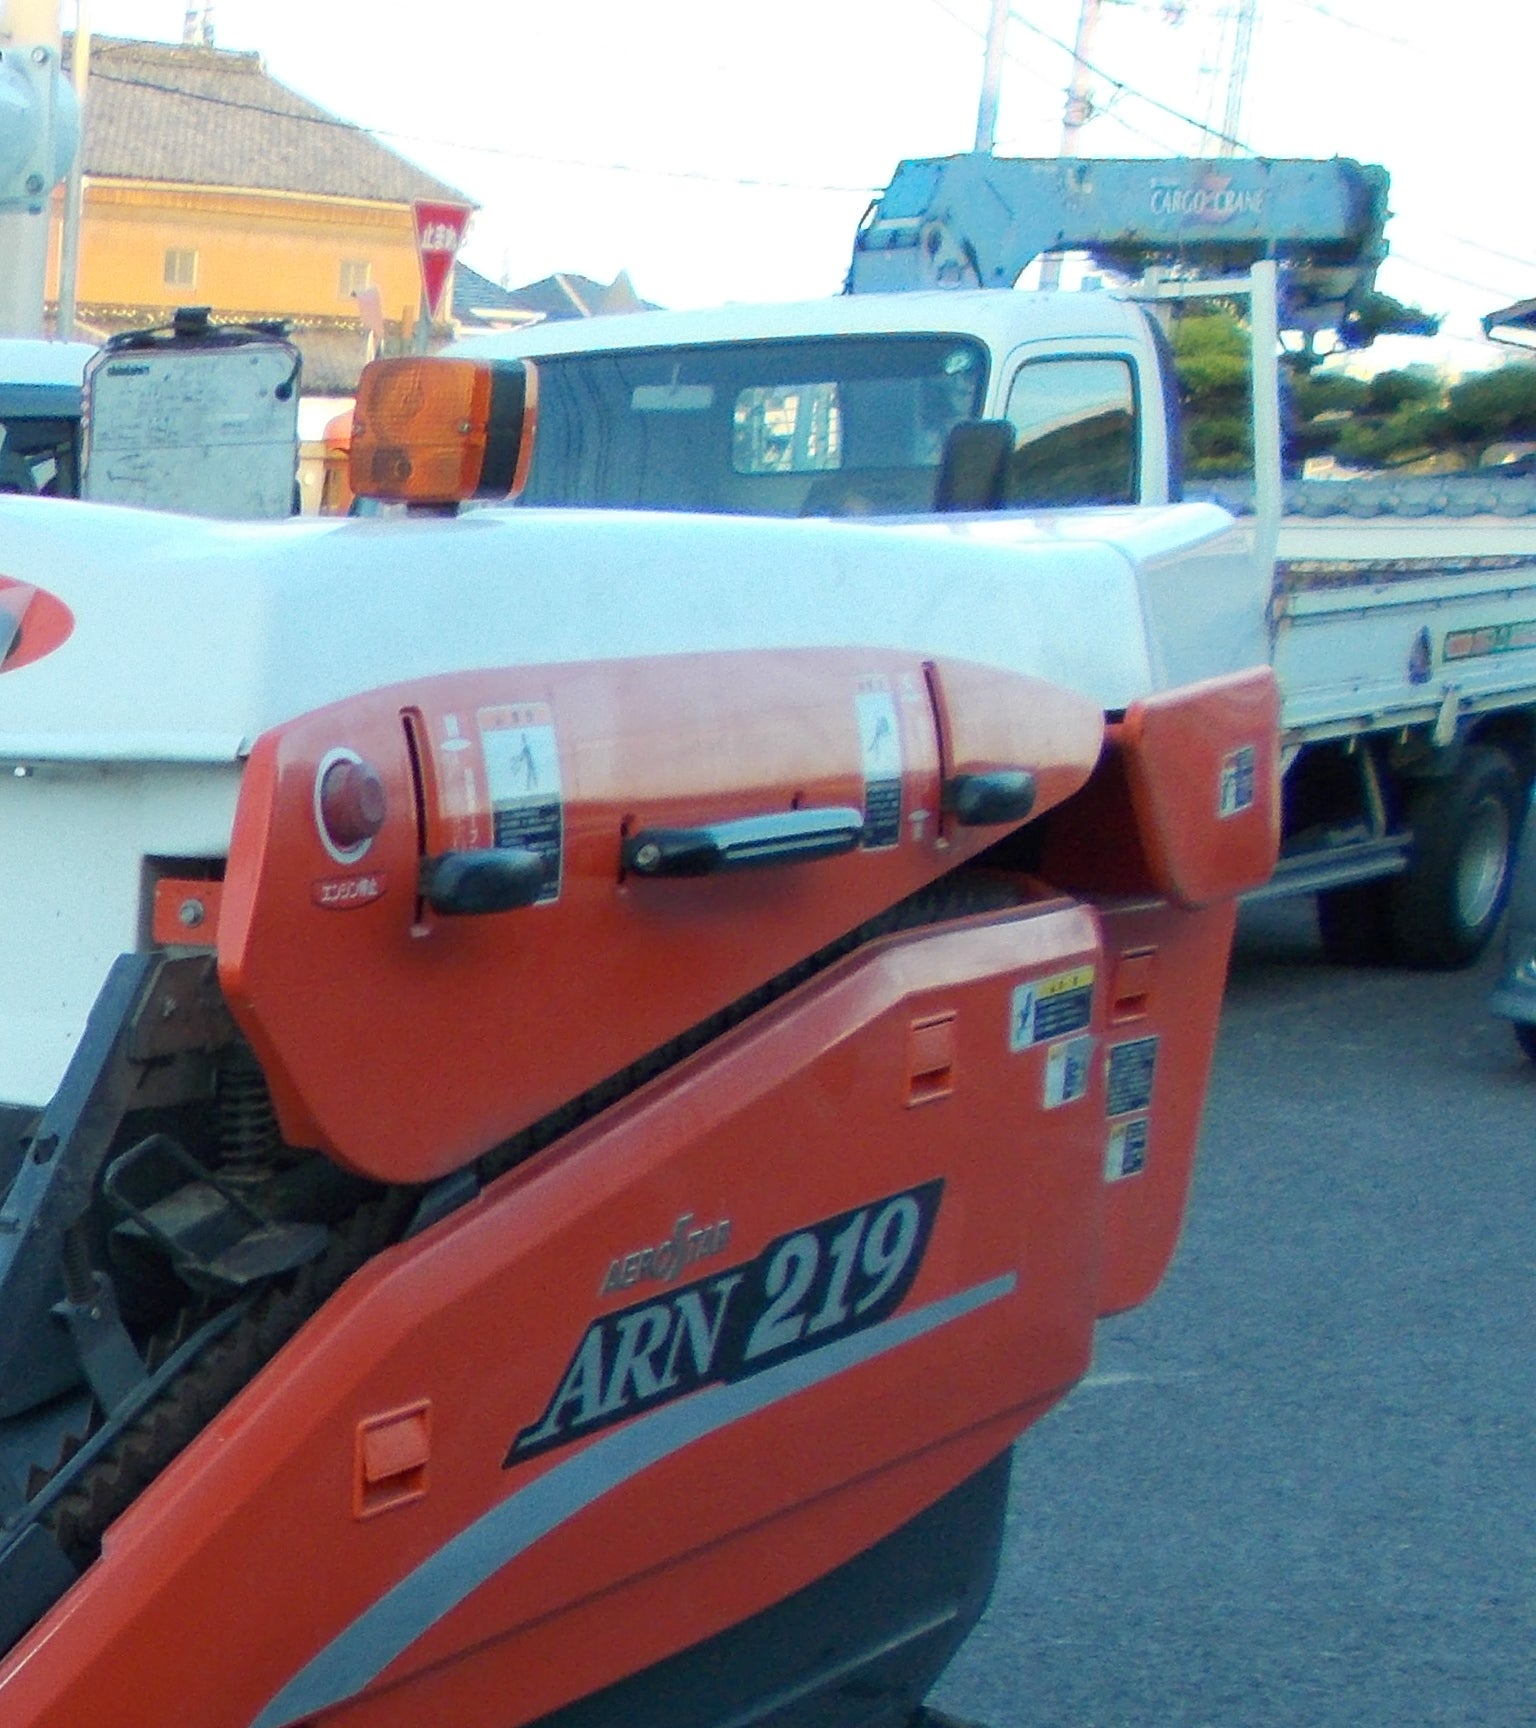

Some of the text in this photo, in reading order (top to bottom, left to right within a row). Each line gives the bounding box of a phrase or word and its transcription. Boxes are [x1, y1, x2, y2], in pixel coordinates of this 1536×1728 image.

[421, 222, 458, 251] 止まれ
[515, 1196, 921, 1450] ARN 219
